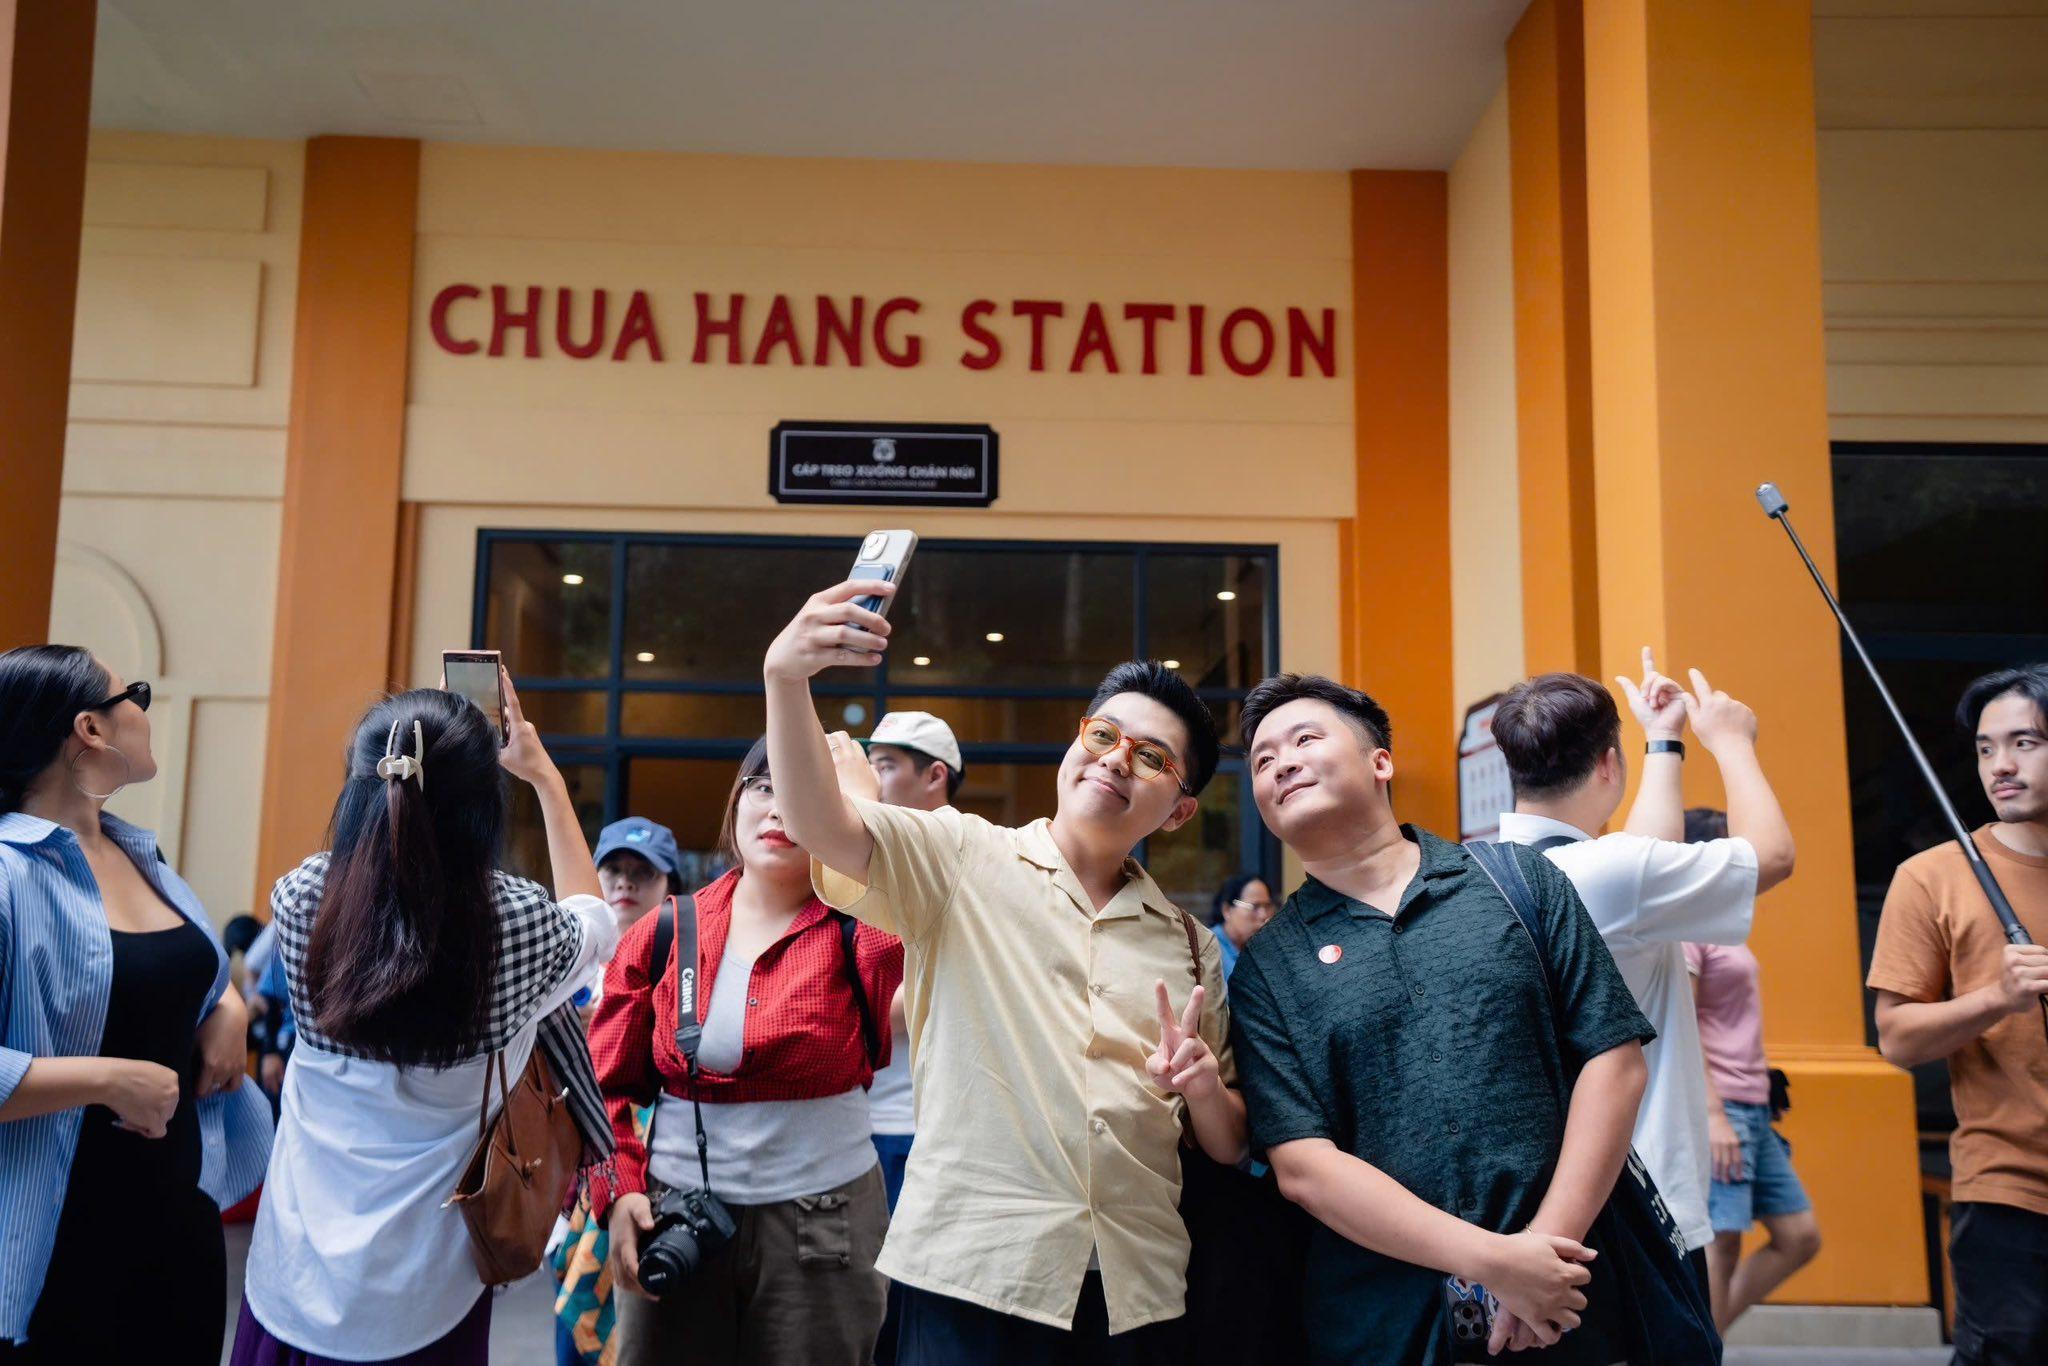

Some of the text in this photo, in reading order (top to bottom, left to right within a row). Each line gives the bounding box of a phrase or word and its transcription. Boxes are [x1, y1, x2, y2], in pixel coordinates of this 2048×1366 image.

[430, 284, 1338, 379] CHUA HANG STATION
[682, 967, 694, 1014] Canon
